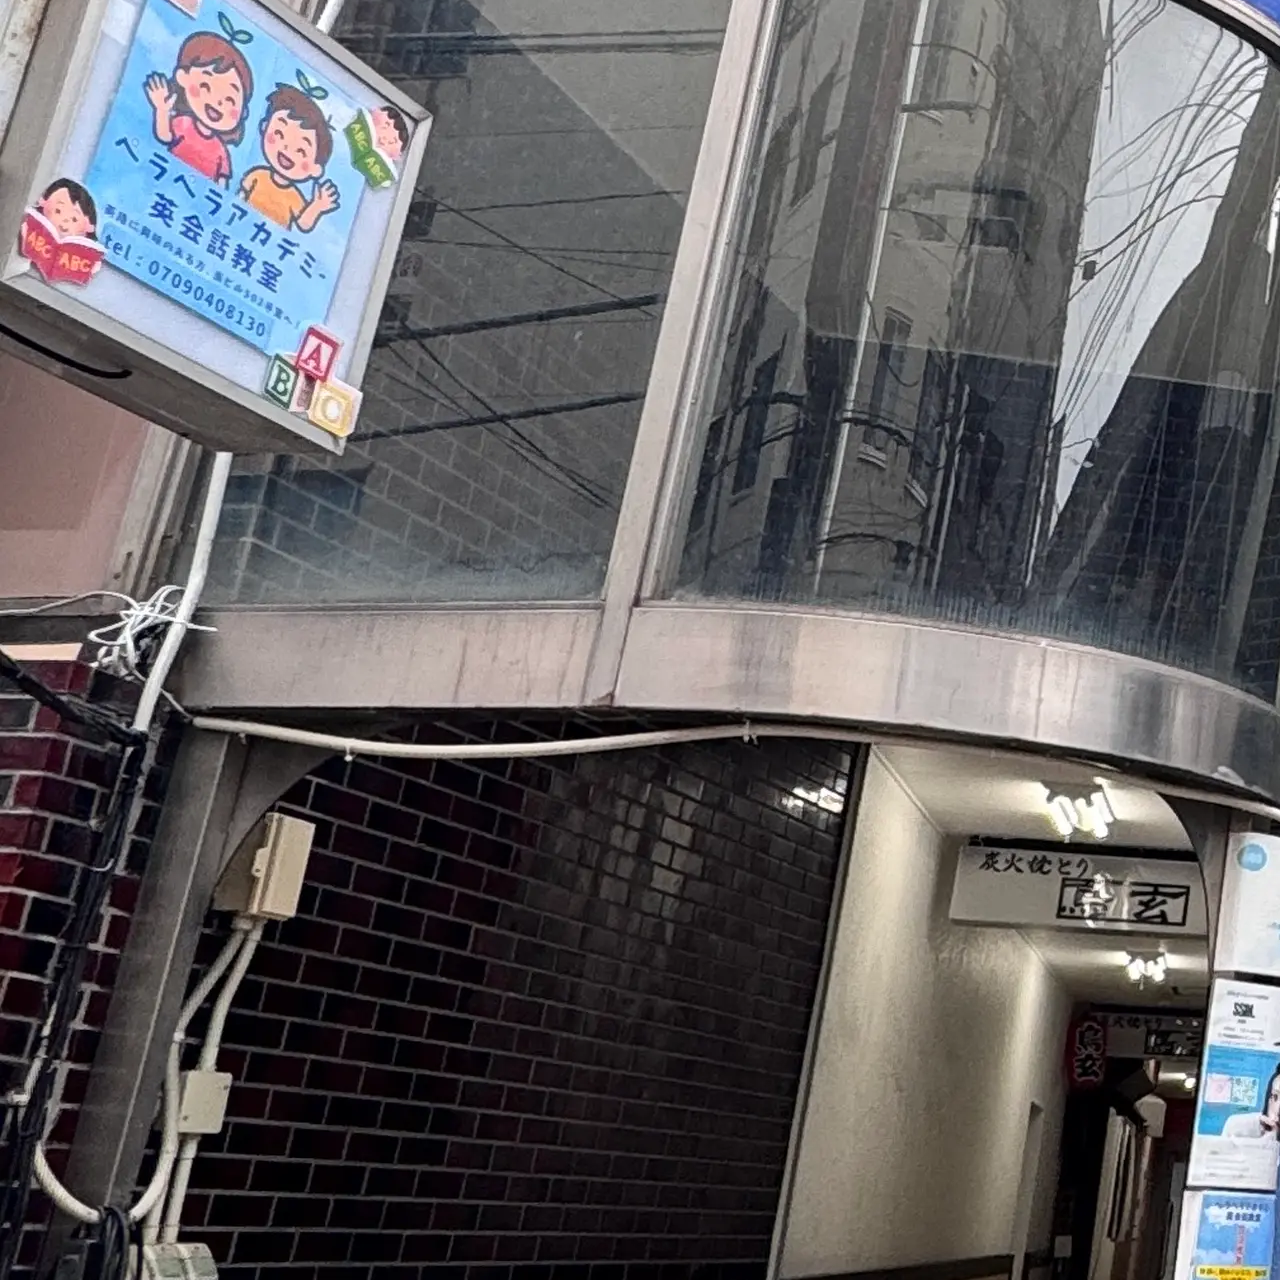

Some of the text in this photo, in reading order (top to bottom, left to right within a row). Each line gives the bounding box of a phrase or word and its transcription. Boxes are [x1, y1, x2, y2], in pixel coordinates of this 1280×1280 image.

[115, 137, 326, 280] ペラペラアカデミー
[26, 229, 51, 259] ABC
[149, 192, 283, 294] 英会話教室
[59, 253, 92, 272] ABC
[302, 341, 326, 373] A
[270, 363, 290, 393] B
